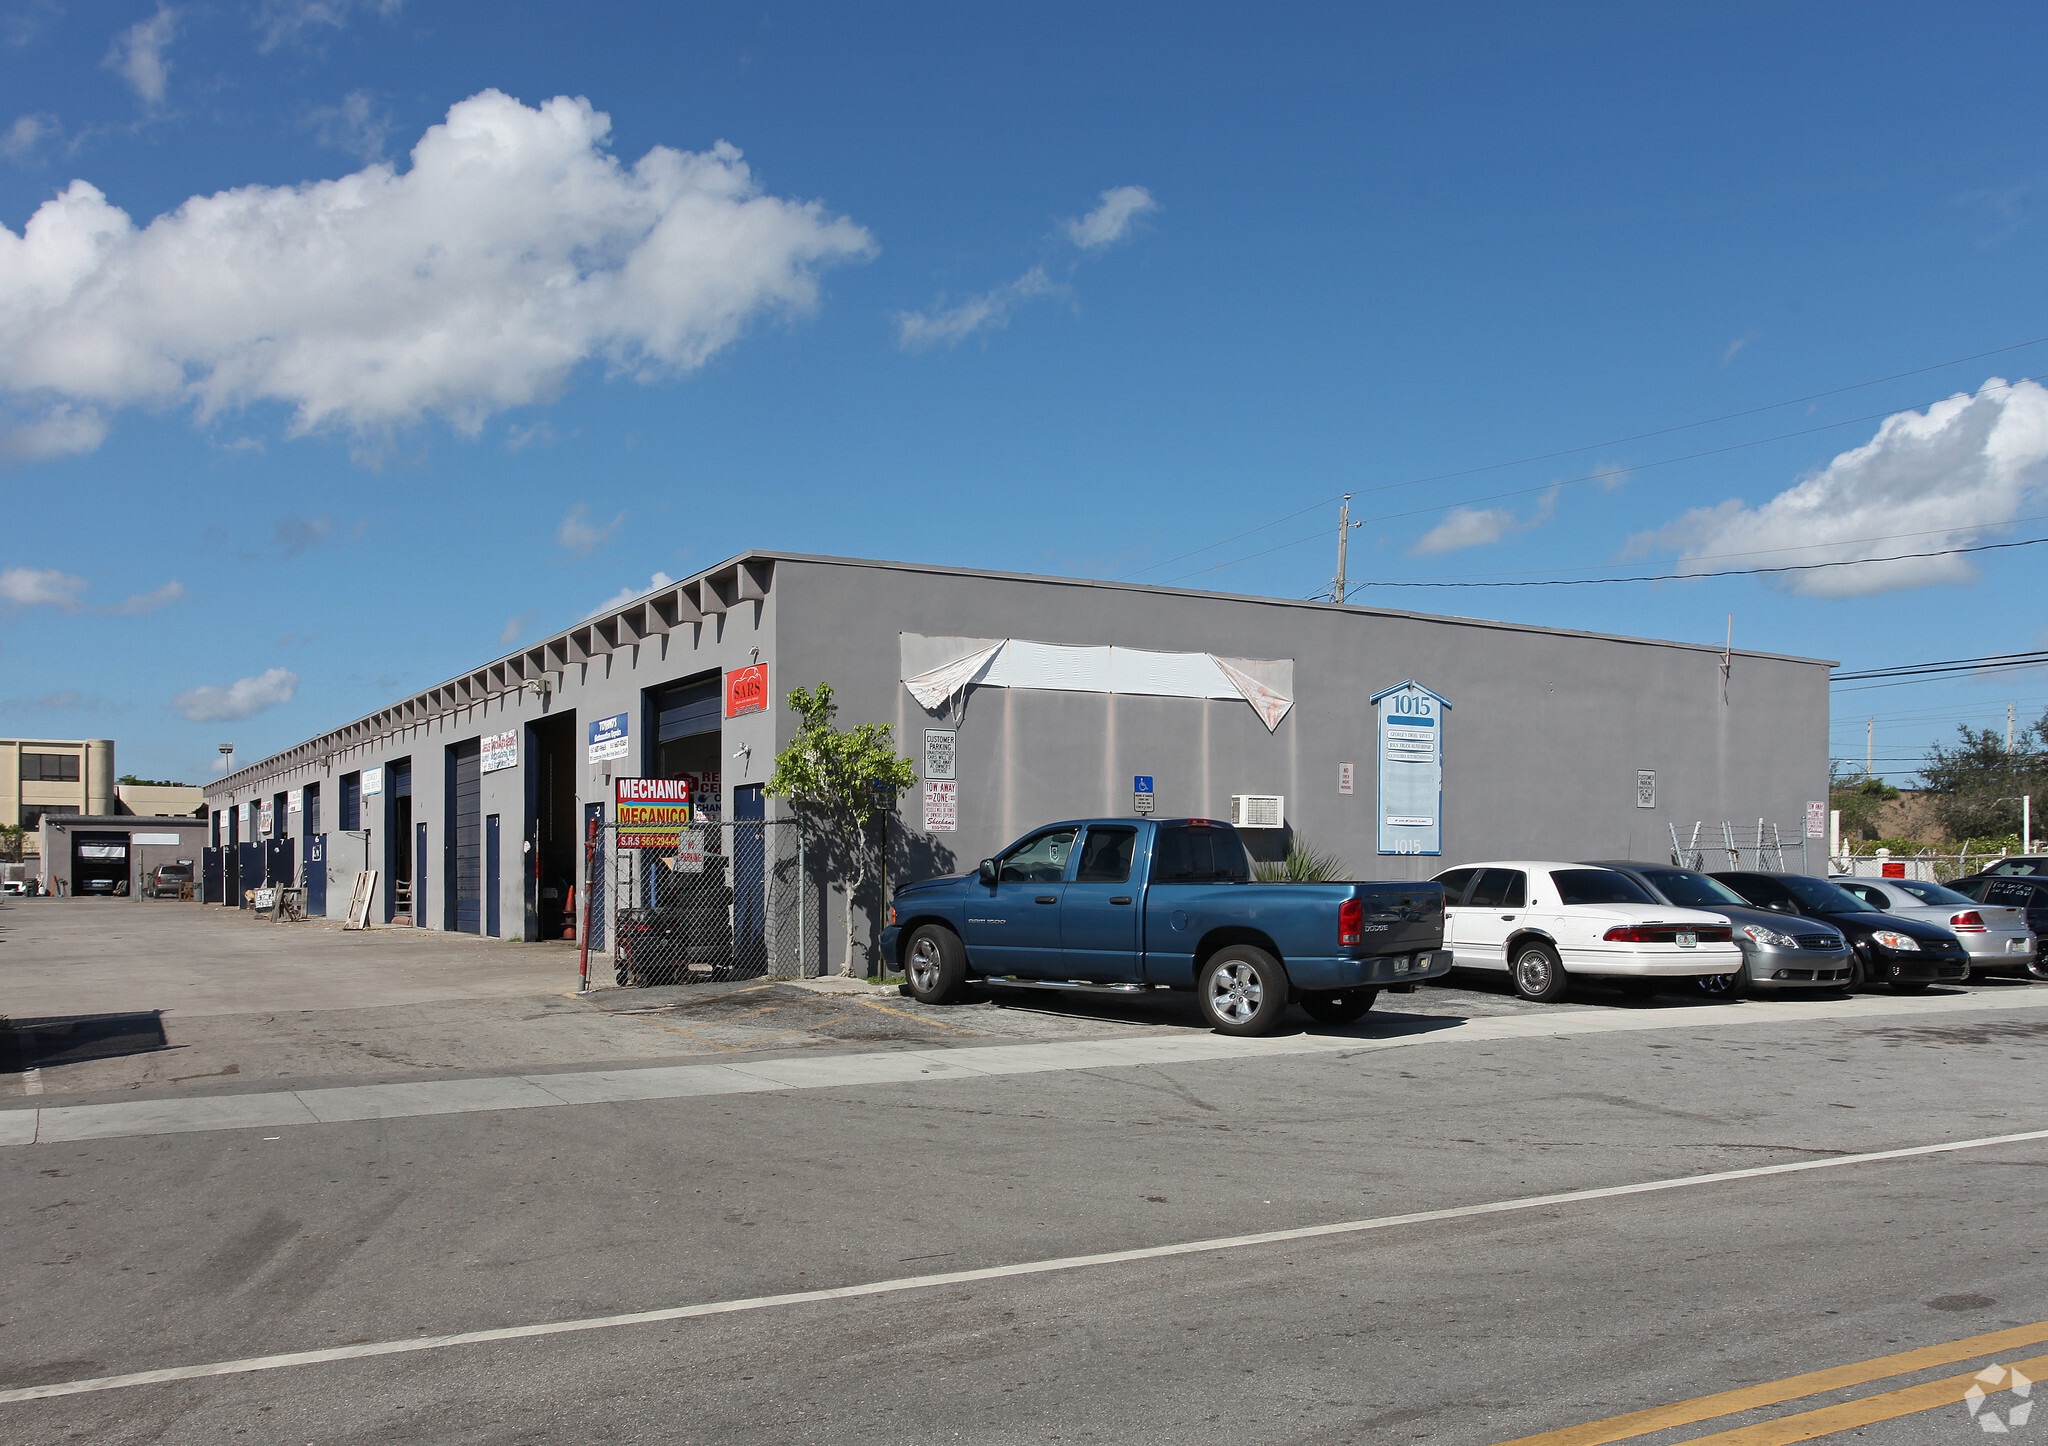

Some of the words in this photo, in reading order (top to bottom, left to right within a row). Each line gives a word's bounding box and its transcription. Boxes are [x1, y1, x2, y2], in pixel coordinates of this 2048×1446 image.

[734, 681, 761, 699] SARS
[1392, 695, 1431, 715] 1015
[702, 772, 721, 782] RE
[620, 779, 686, 799] MECHANIC
[700, 783, 721, 793] CE
[926, 783, 938, 791] TOW
[940, 783, 955, 792] AWAY
[933, 793, 948, 802] ZONE
[595, 806, 601, 817] 2
[620, 808, 687, 824] MECANICO
[1395, 840, 1421, 854] 1015
[1364, 924, 1388, 932] DODGE
